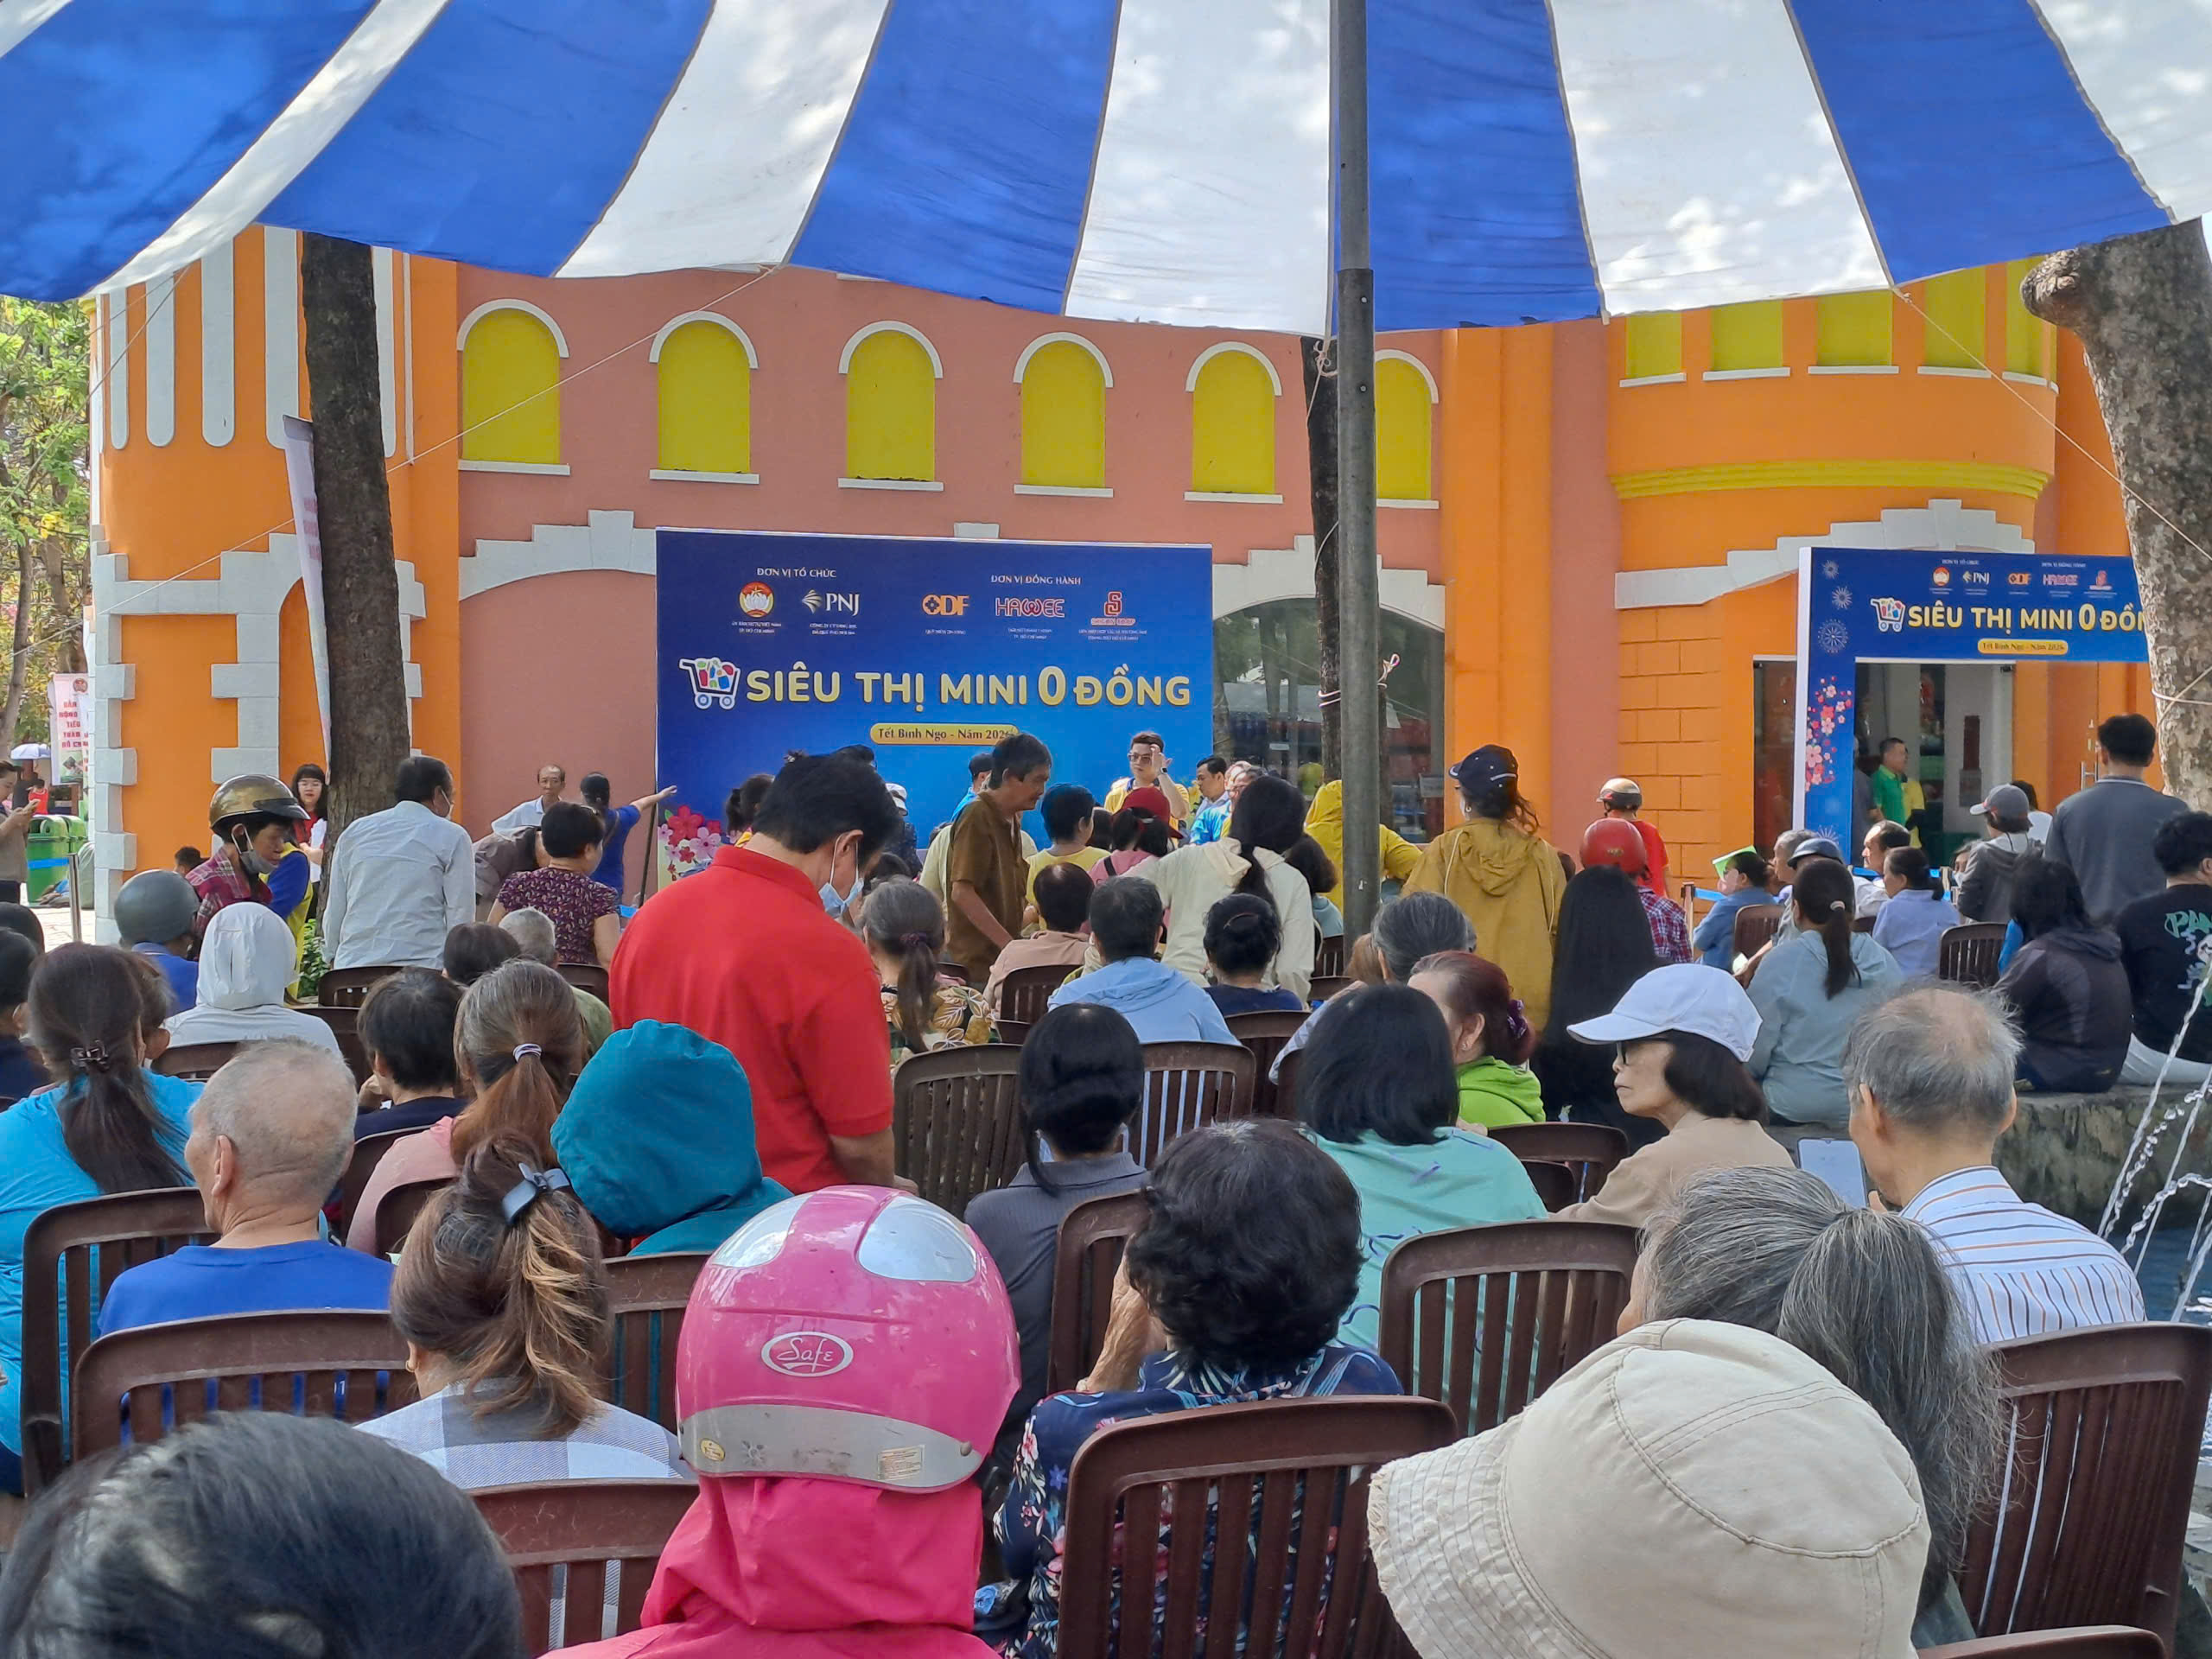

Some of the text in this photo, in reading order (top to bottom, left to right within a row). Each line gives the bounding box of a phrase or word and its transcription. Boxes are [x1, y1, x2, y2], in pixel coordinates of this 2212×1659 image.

[757, 566, 837, 579] ĐƠN VỊ TỔ CHỨC
[991, 575, 1014, 584] ĐƠN
[1014, 575, 1024, 585] VỊ
[1973, 571, 1990, 585] PNJ
[825, 593, 861, 616] PNJ
[995, 596, 1065, 618] HAWEE
[1908, 600, 1962, 628] SIÊU
[1970, 607, 2012, 635] THỊ
[2020, 607, 2073, 631] MINI
[2078, 602, 2096, 631] 0
[747, 660, 1190, 713] SIÊU THỊ MINI 0 ĐỒNG
[879, 727, 894, 739] Tết
[957, 728, 982, 740] Năm
[776, 1337, 834, 1372] Safe
